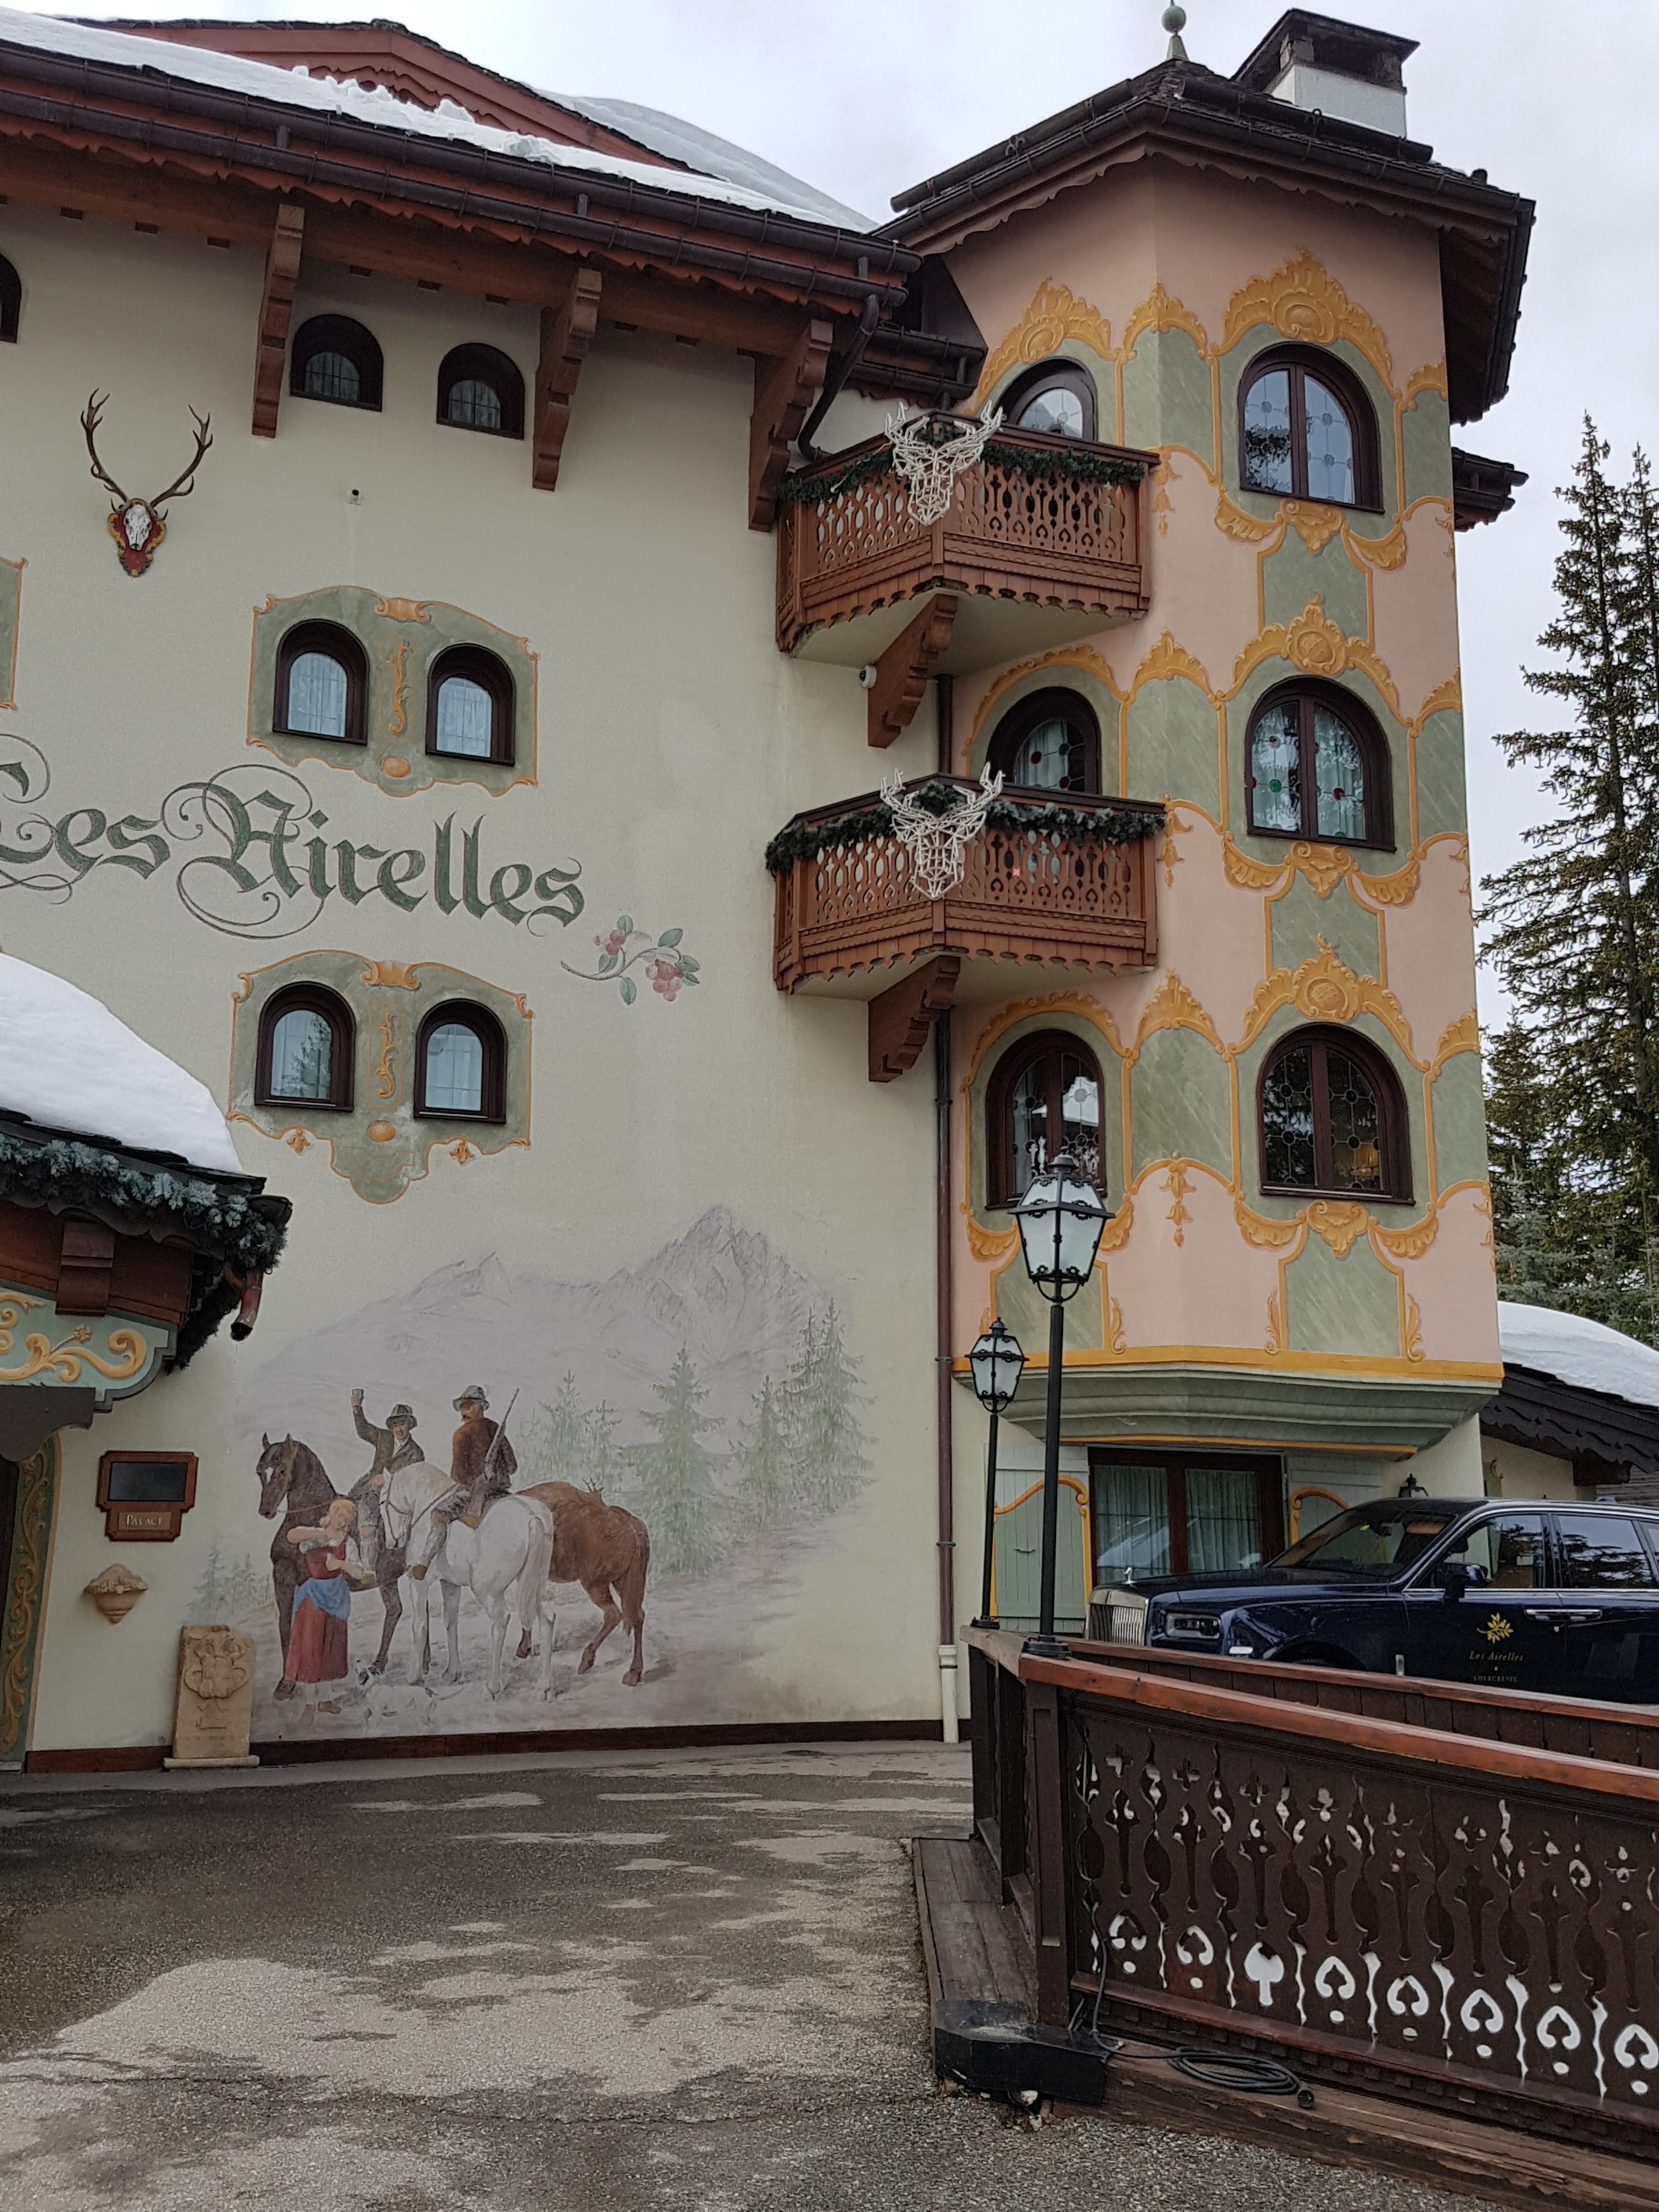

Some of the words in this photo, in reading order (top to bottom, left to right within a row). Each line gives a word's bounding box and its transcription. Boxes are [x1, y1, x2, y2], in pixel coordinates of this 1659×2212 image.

[161, 764, 585, 939] Airelles
[126, 1514, 163, 1526] PALACE
[1469, 1650, 1485, 1660] Les
[1487, 1651, 1524, 1661] Airelles
